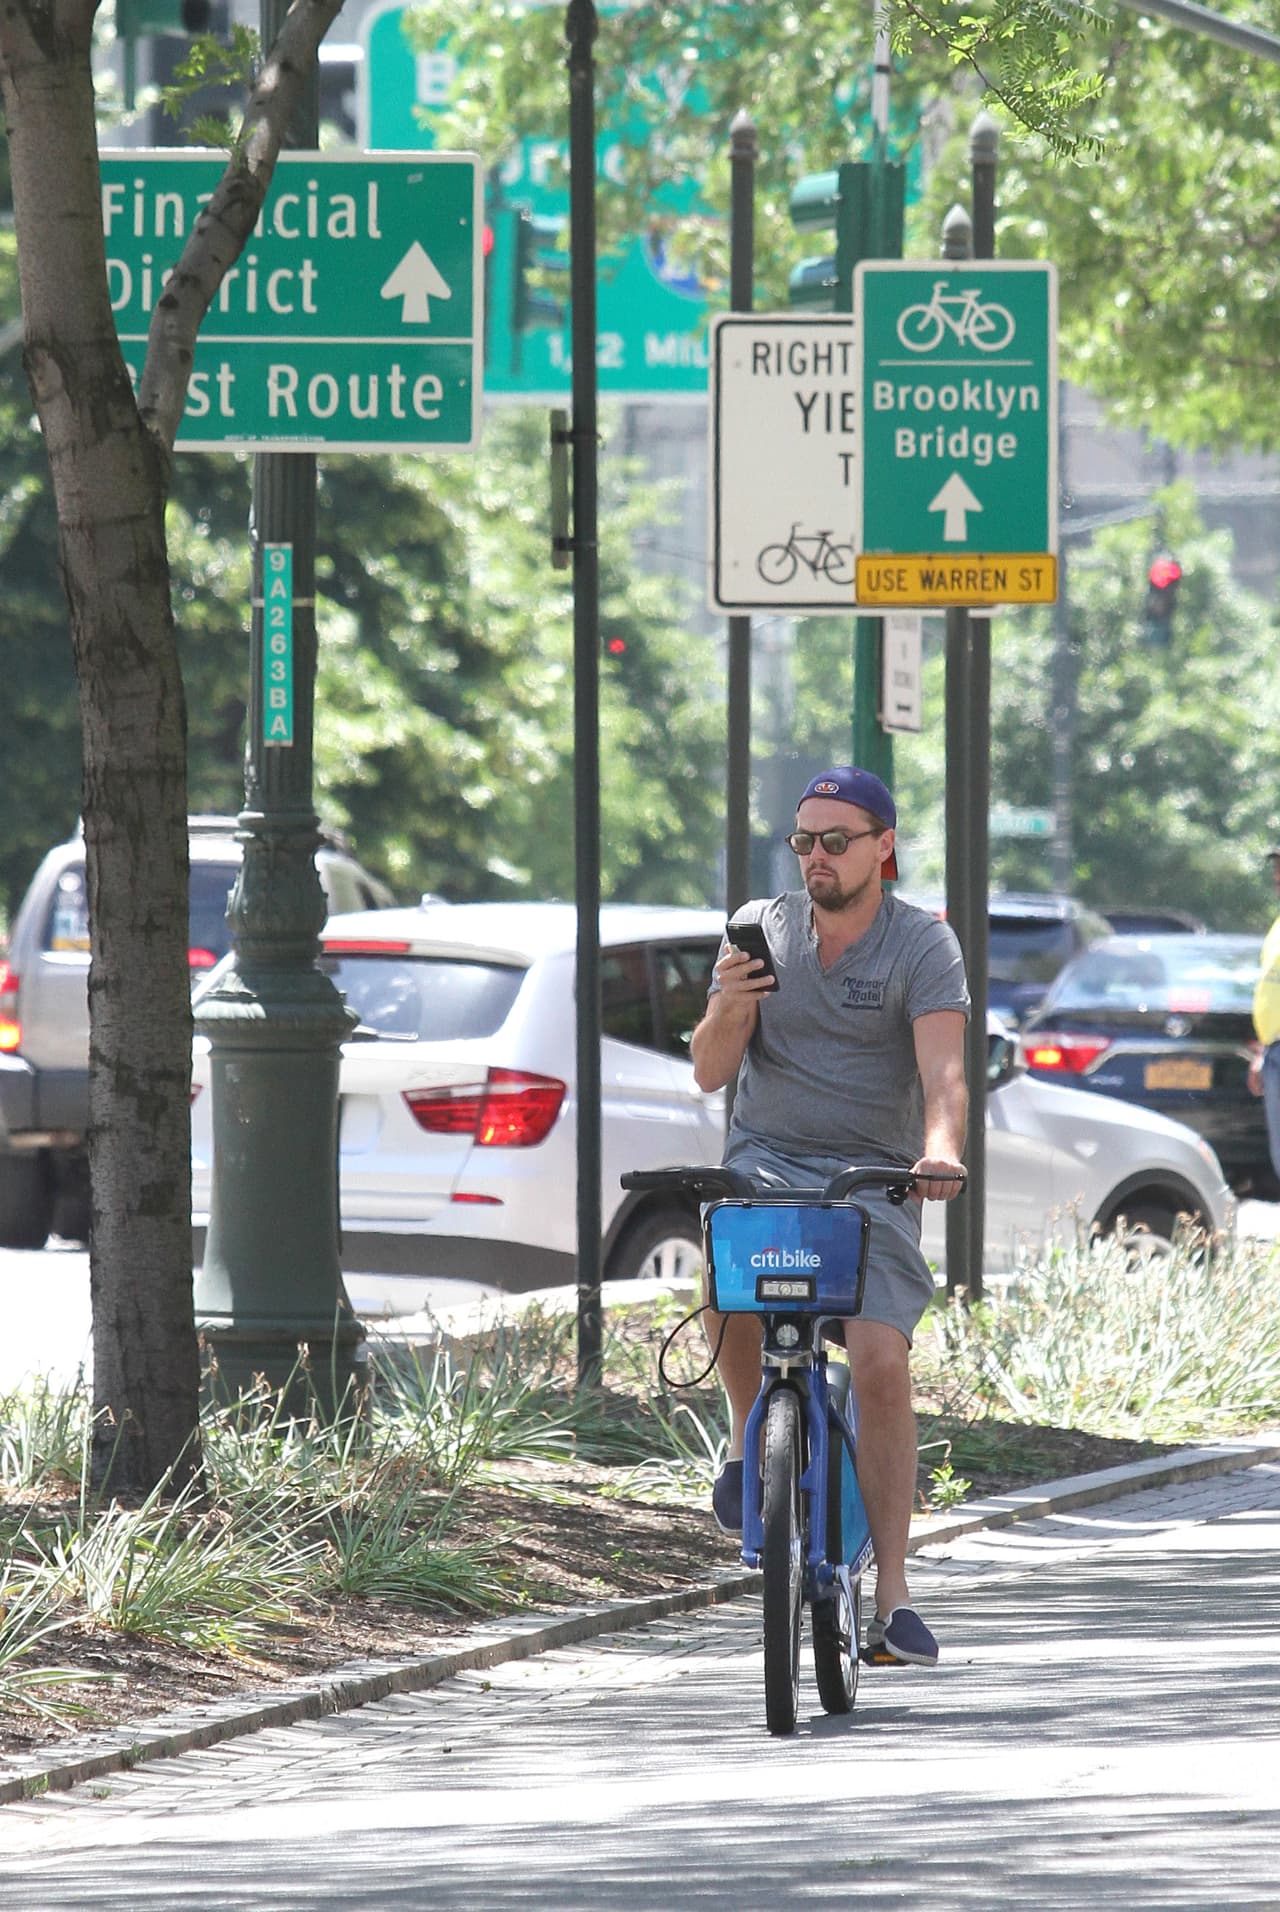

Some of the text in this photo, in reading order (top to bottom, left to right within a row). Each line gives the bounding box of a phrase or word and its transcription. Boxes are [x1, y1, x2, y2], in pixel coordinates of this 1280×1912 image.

[101, 178, 381, 239] Fincial
[106, 253, 318, 314] Dirict
[645, 332, 709, 368] MIL
[752, 341, 854, 376] RIGHT
[267, 363, 444, 419] Route
[795, 391, 855, 433] YIE
[873, 379, 1040, 419] Brooklyn
[895, 424, 1017, 466] Bridge
[838, 453, 855, 486] T
[867, 568, 1043, 592] USE WARREN ST
[269, 551, 288, 736] 9A263BA
